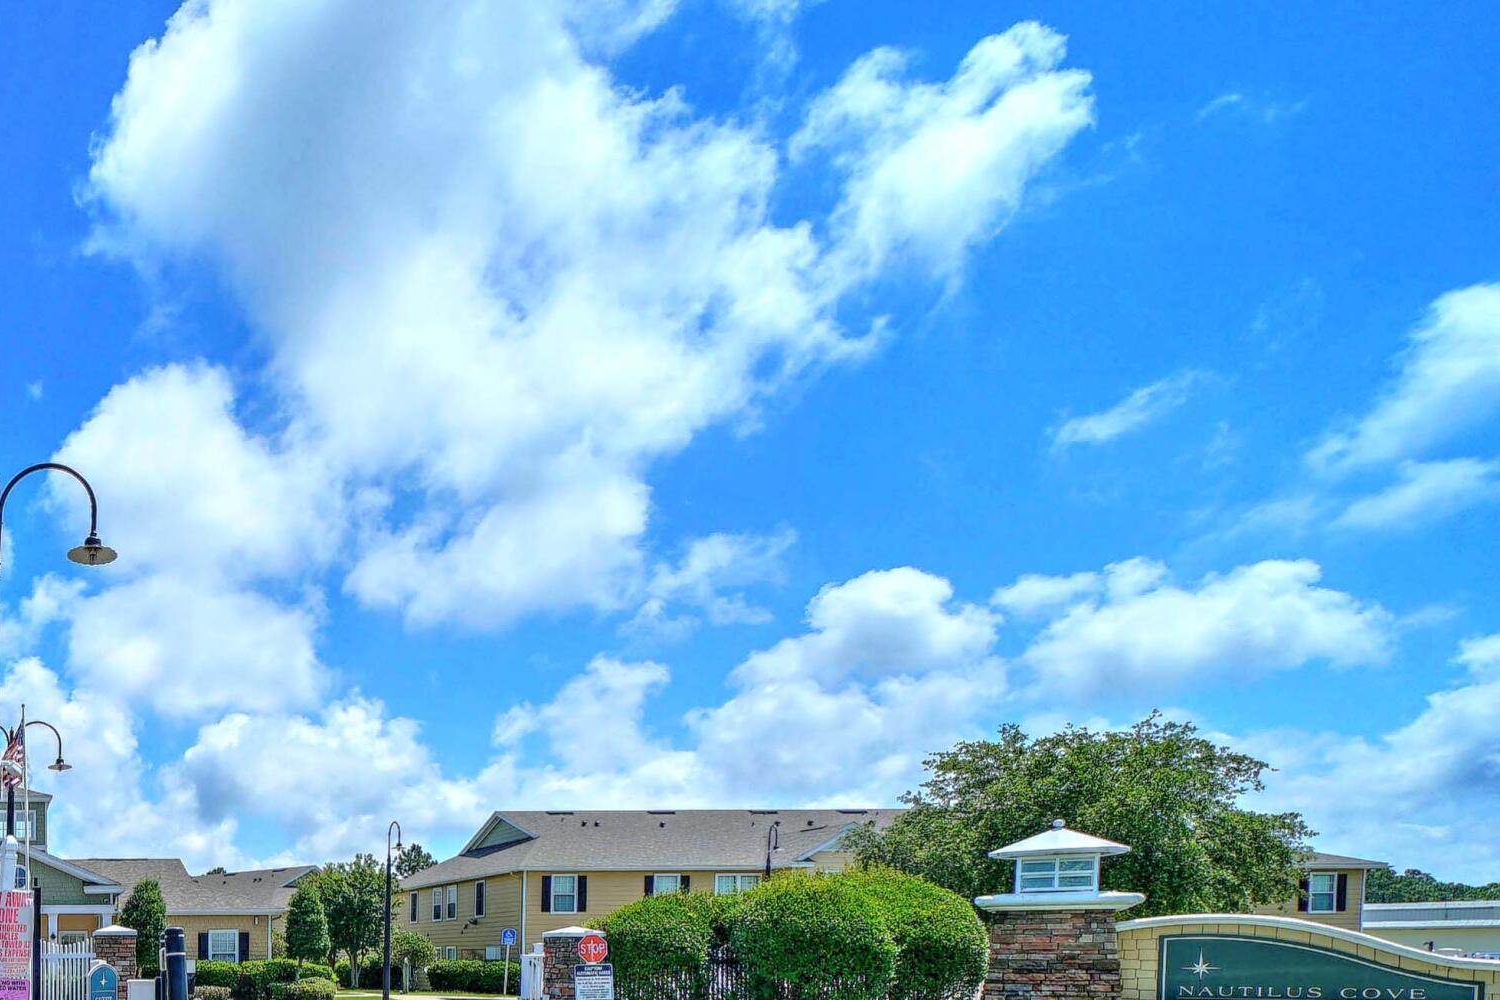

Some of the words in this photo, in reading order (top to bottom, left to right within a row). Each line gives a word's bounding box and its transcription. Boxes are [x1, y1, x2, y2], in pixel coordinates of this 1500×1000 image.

[1, 941, 22, 949] TOWED
[580, 943, 605, 954] STOP
[4, 949, 32, 958] EXPENSE
[1179, 985, 1322, 999] NAUTILUS
[1340, 987, 1427, 1000] COVE
